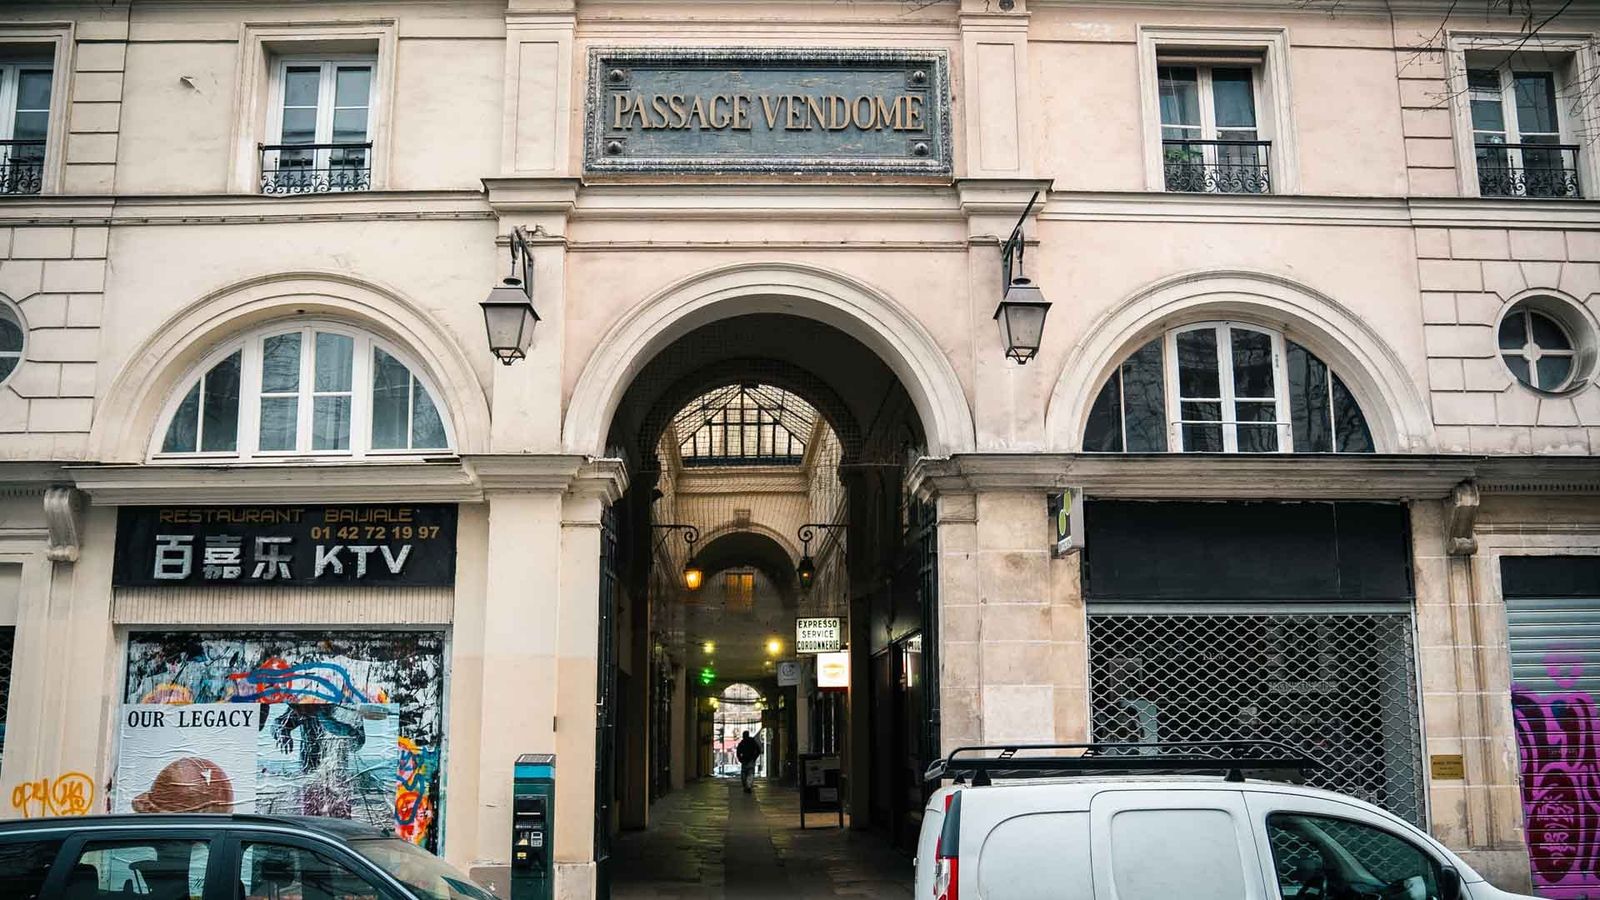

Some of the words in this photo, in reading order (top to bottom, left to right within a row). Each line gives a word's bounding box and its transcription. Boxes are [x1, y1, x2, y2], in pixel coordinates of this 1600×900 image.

[612, 94, 752, 131] PASSAGE
[759, 94, 925, 131] VENDOME
[159, 508, 304, 524] RESTAURANT
[324, 508, 414, 523] BAIJIALE
[311, 526, 330, 540] 01
[337, 526, 359, 540] 42
[364, 526, 385, 540] 72
[392, 526, 413, 540] 19
[418, 526, 440, 540] 97
[153, 534, 293, 580] 百嘉乐
[314, 544, 412, 578] KTV
[798, 620, 838, 628] EXPRESSO
[802, 630, 834, 638] SERVICE
[797, 640, 840, 650] CORDONNERIE
[127, 710, 165, 728] OUR
[178, 710, 253, 728] LEGACY
